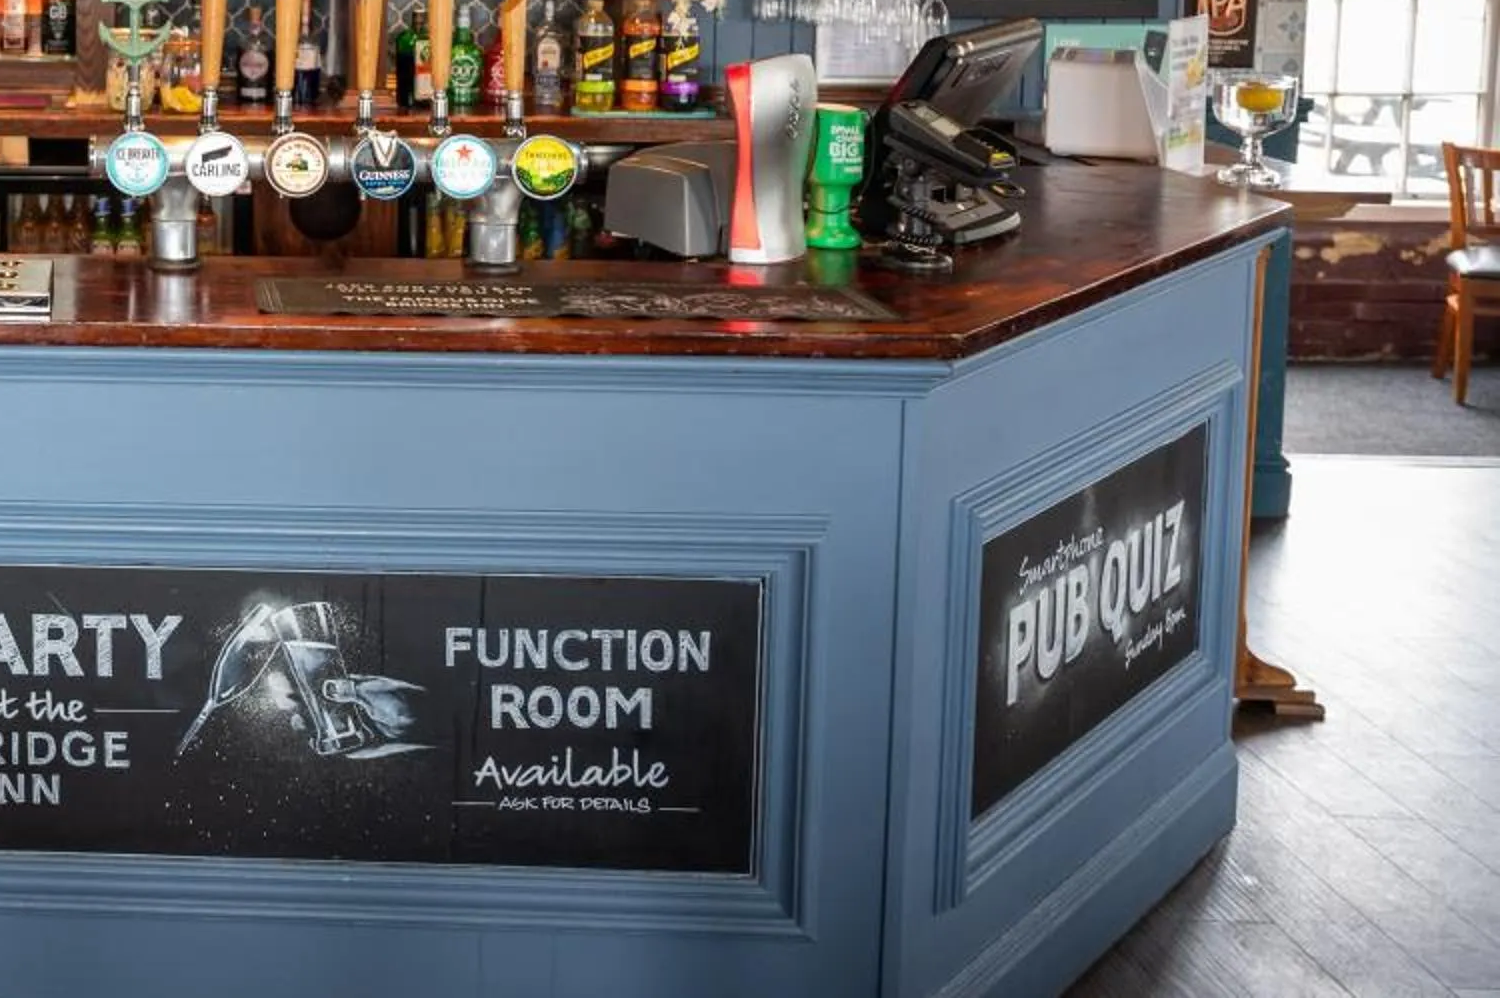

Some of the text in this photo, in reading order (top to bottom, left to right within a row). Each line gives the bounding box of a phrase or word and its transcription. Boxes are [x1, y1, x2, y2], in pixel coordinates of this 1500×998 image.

[829, 142, 860, 157] BIG
[191, 163, 241, 178] CARLING
[359, 170, 411, 181] GUINNESS
[1006, 499, 1185, 707] PUB QUIZ
[444, 627, 711, 672] FUNCTION
[17, 689, 88, 722] the
[491, 684, 652, 730] ROOM
[472, 746, 670, 790] Available
[499, 796, 651, 813] ASK FOR DETAILS
